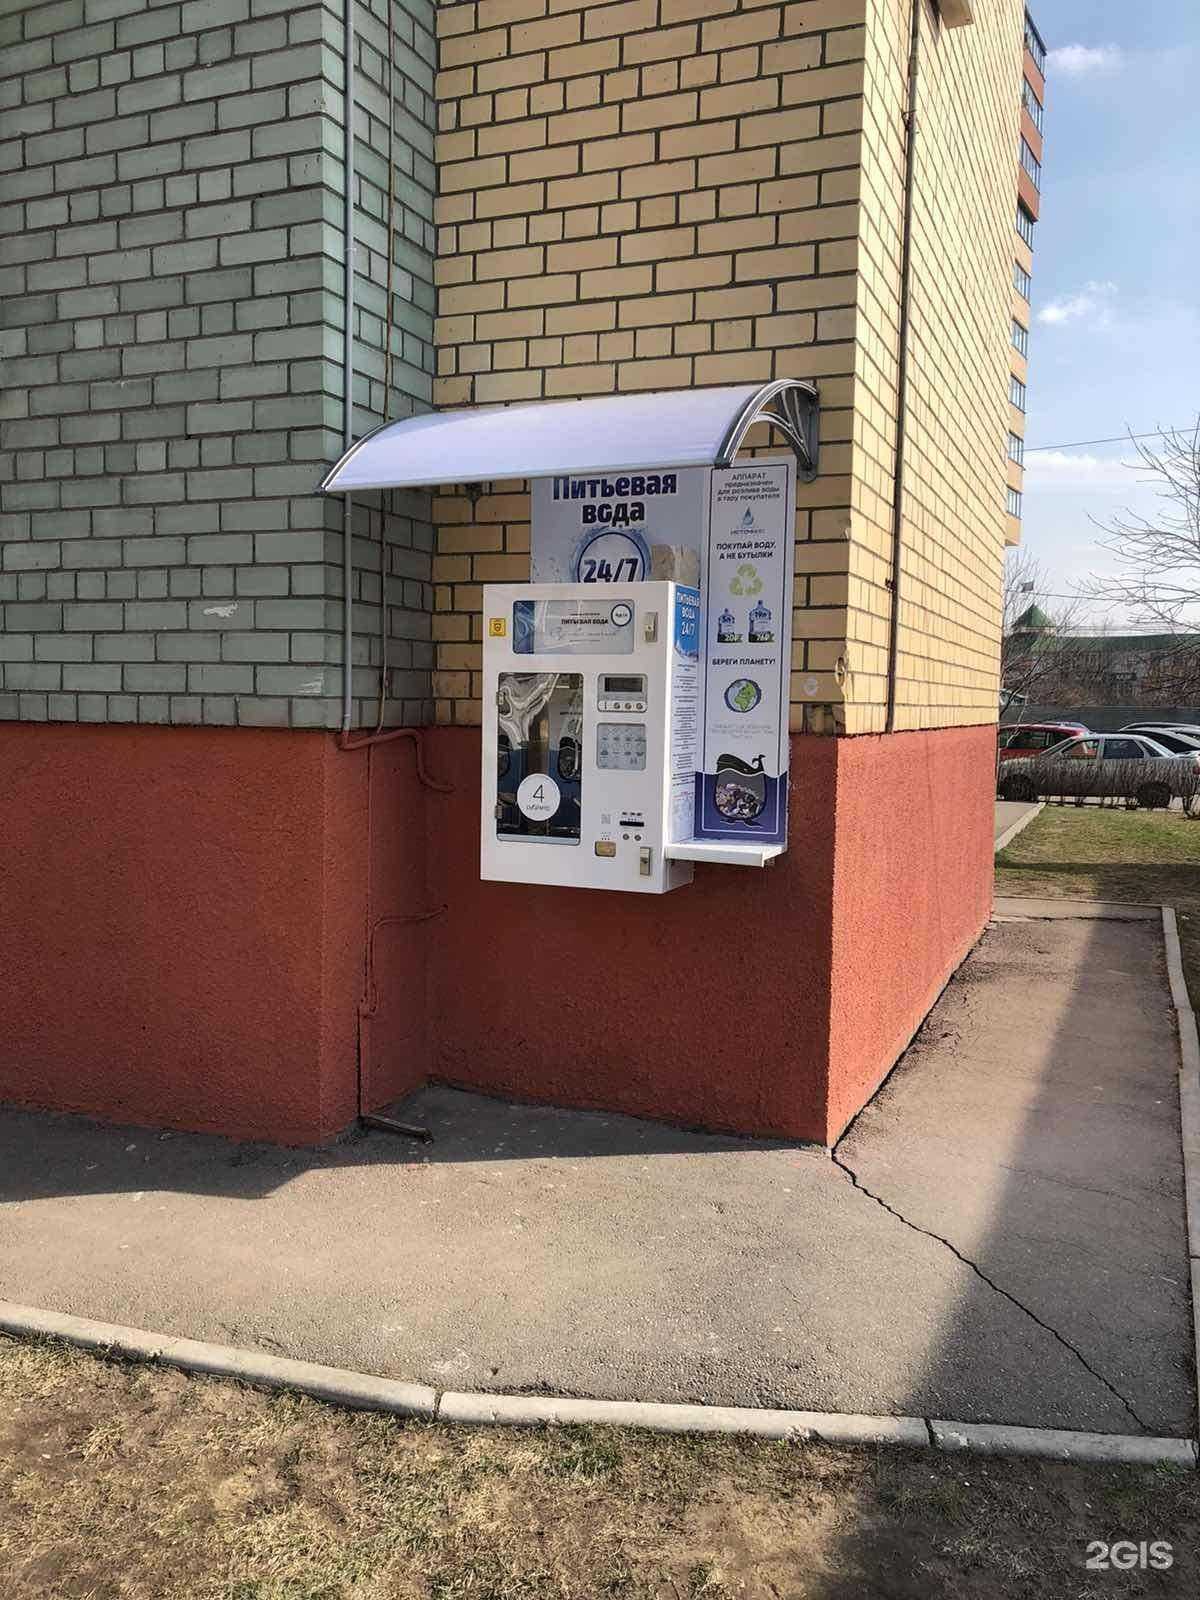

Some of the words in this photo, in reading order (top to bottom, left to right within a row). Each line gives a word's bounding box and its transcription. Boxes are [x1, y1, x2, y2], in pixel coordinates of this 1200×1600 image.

[732, 472, 767, 480] АППАРАТ
[553, 474, 677, 500] Питьевая
[582, 501, 645, 527] вода
[716, 540, 753, 550] ПОКУПАЙ
[726, 552, 736, 560] НЕ
[737, 551, 774, 560] БУТЫЛКИ
[583, 558, 639, 583] 24/7
[712, 658, 738, 666] БЕРЕГИ
[739, 657, 776, 666] ПЛАНЕТУ!
[533, 784, 544, 803] 4
